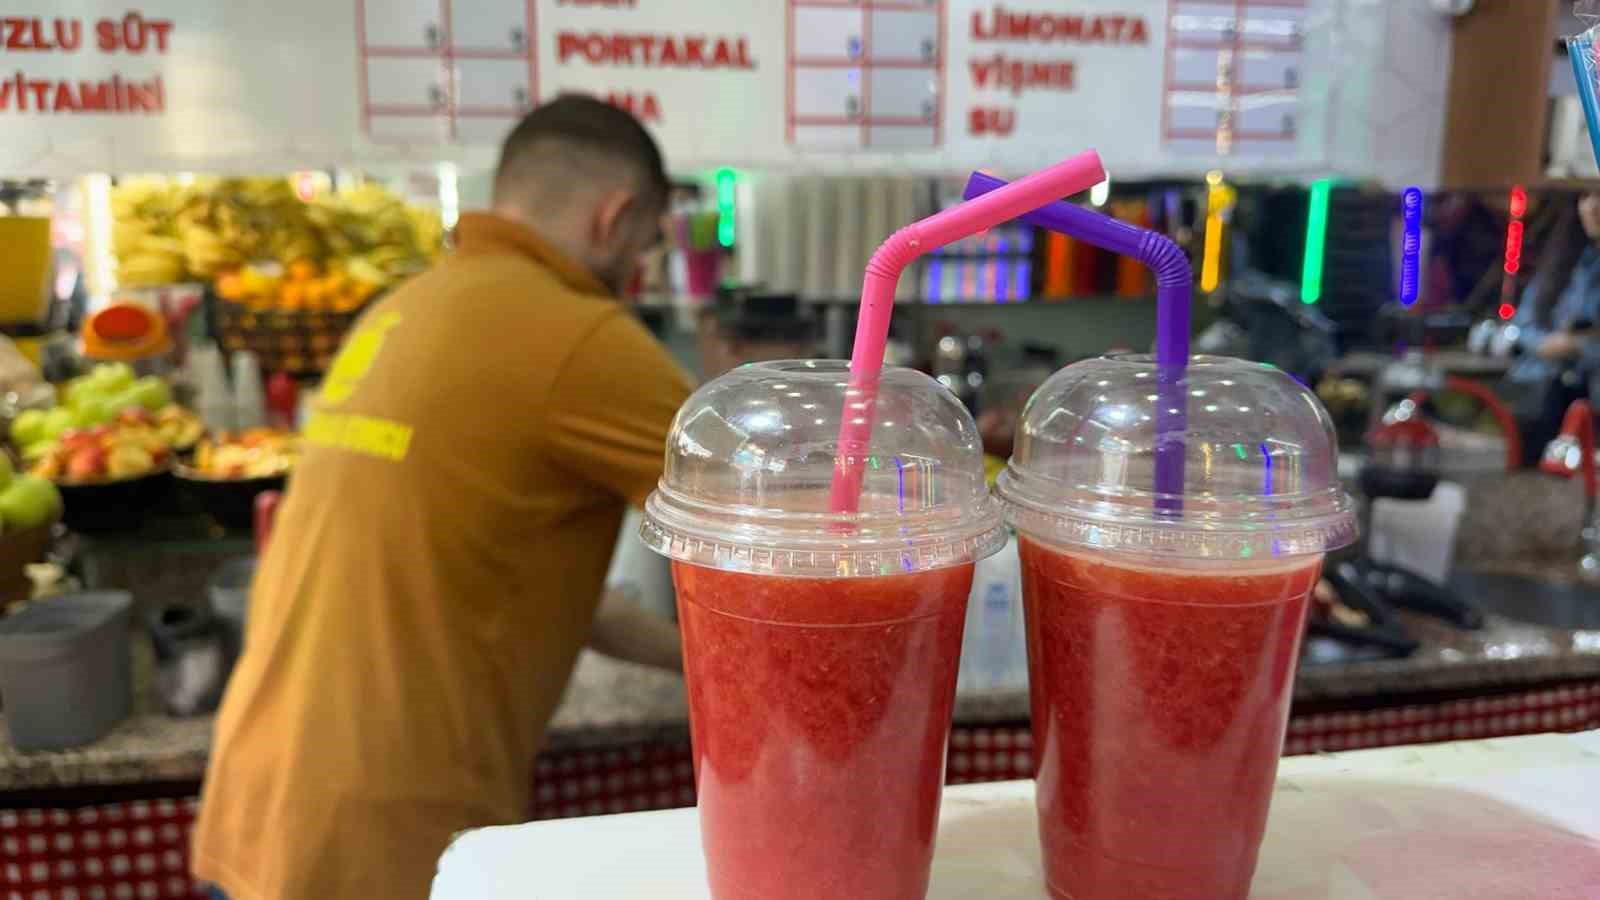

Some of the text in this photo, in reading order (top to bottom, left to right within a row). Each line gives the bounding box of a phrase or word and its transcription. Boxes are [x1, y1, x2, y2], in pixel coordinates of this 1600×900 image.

[0, 17, 81, 51] ZLU
[969, 6, 1148, 43] LİMONATA
[556, 32, 756, 69] PORTAKAL
[969, 54, 1075, 96] VİŞNE
[969, 108, 1015, 137] SU
